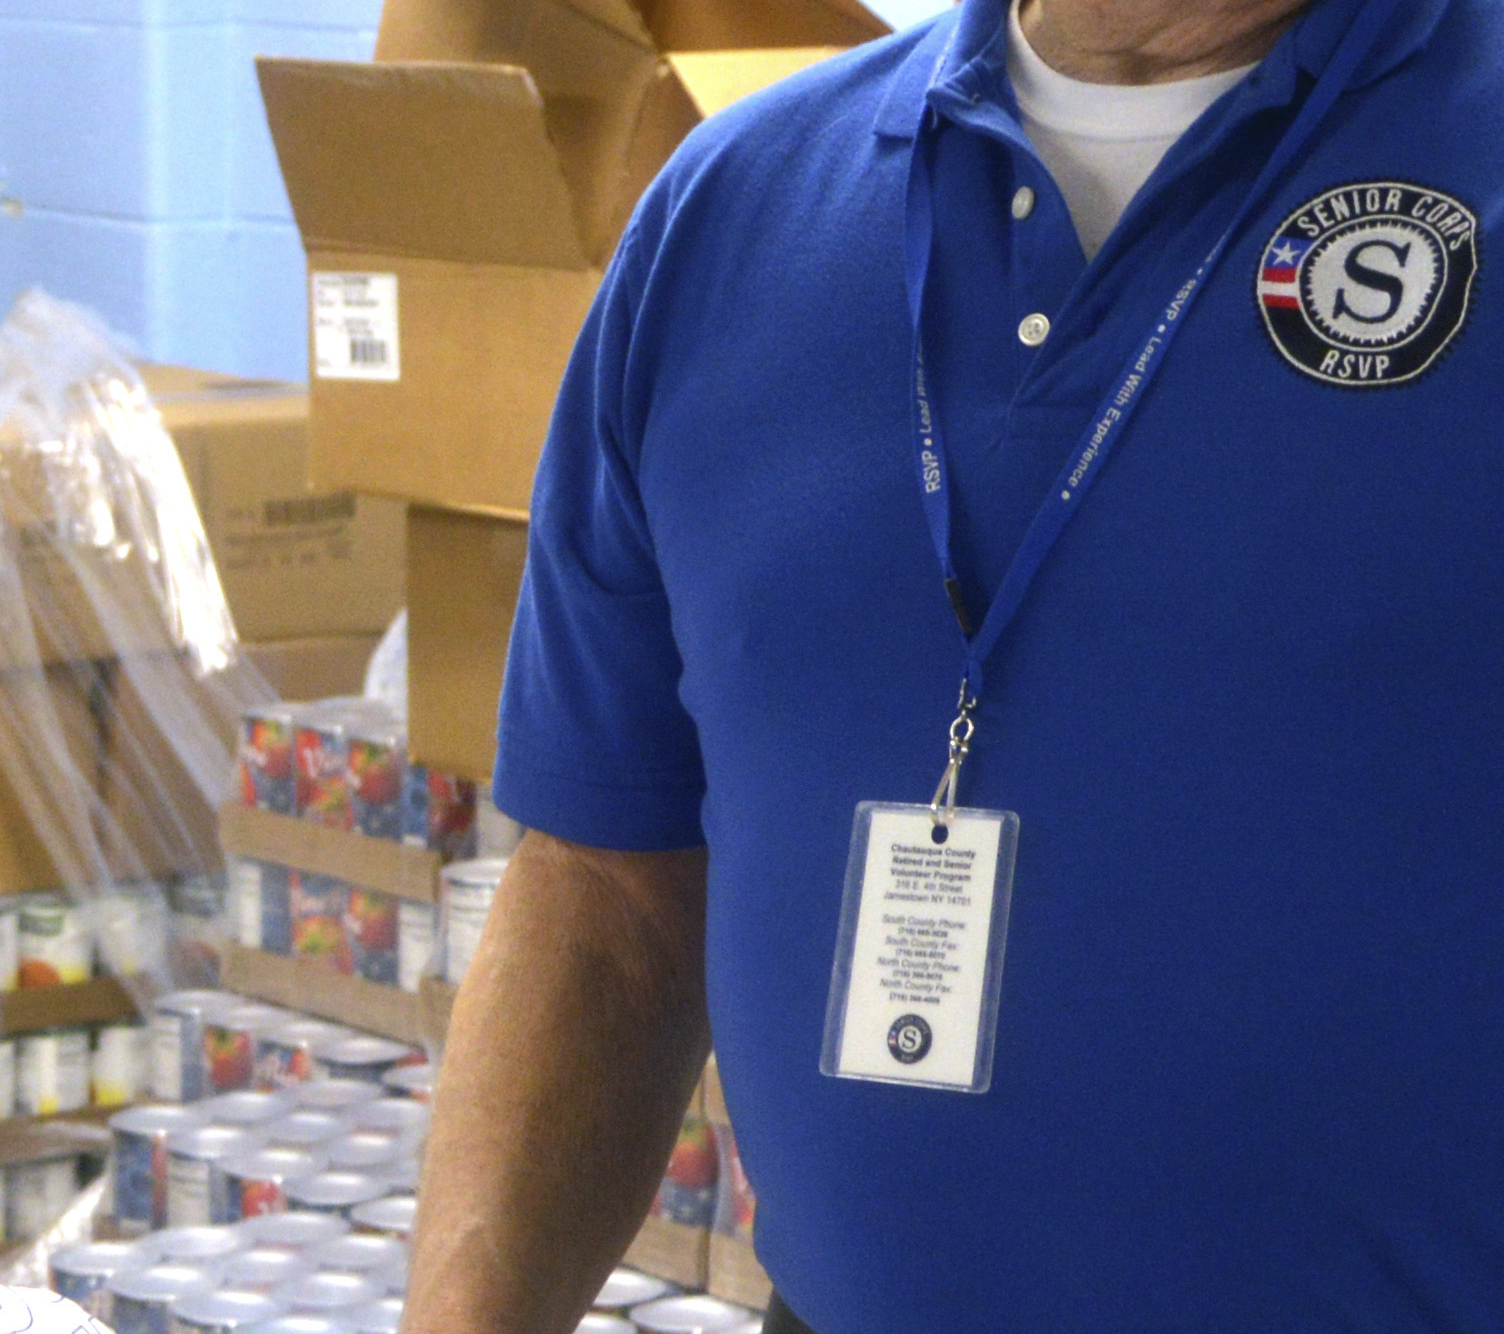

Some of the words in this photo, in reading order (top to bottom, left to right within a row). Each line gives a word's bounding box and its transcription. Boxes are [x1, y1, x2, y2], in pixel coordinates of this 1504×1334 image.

[1298, 188, 1401, 237] SENIOR
[1411, 196, 1470, 251] CORPS
[1332, 239, 1411, 324] S
[1136, 337, 1161, 373] Lead
[1320, 350, 1390, 379] RSVP
[1114, 373, 1141, 407] With
[1069, 407, 1121, 487] Experience
[922, 450, 940, 493] RSVP
[891, 868, 931, 878] Volunteer
[934, 872, 971, 882] Program
[926, 859, 941, 867] and
